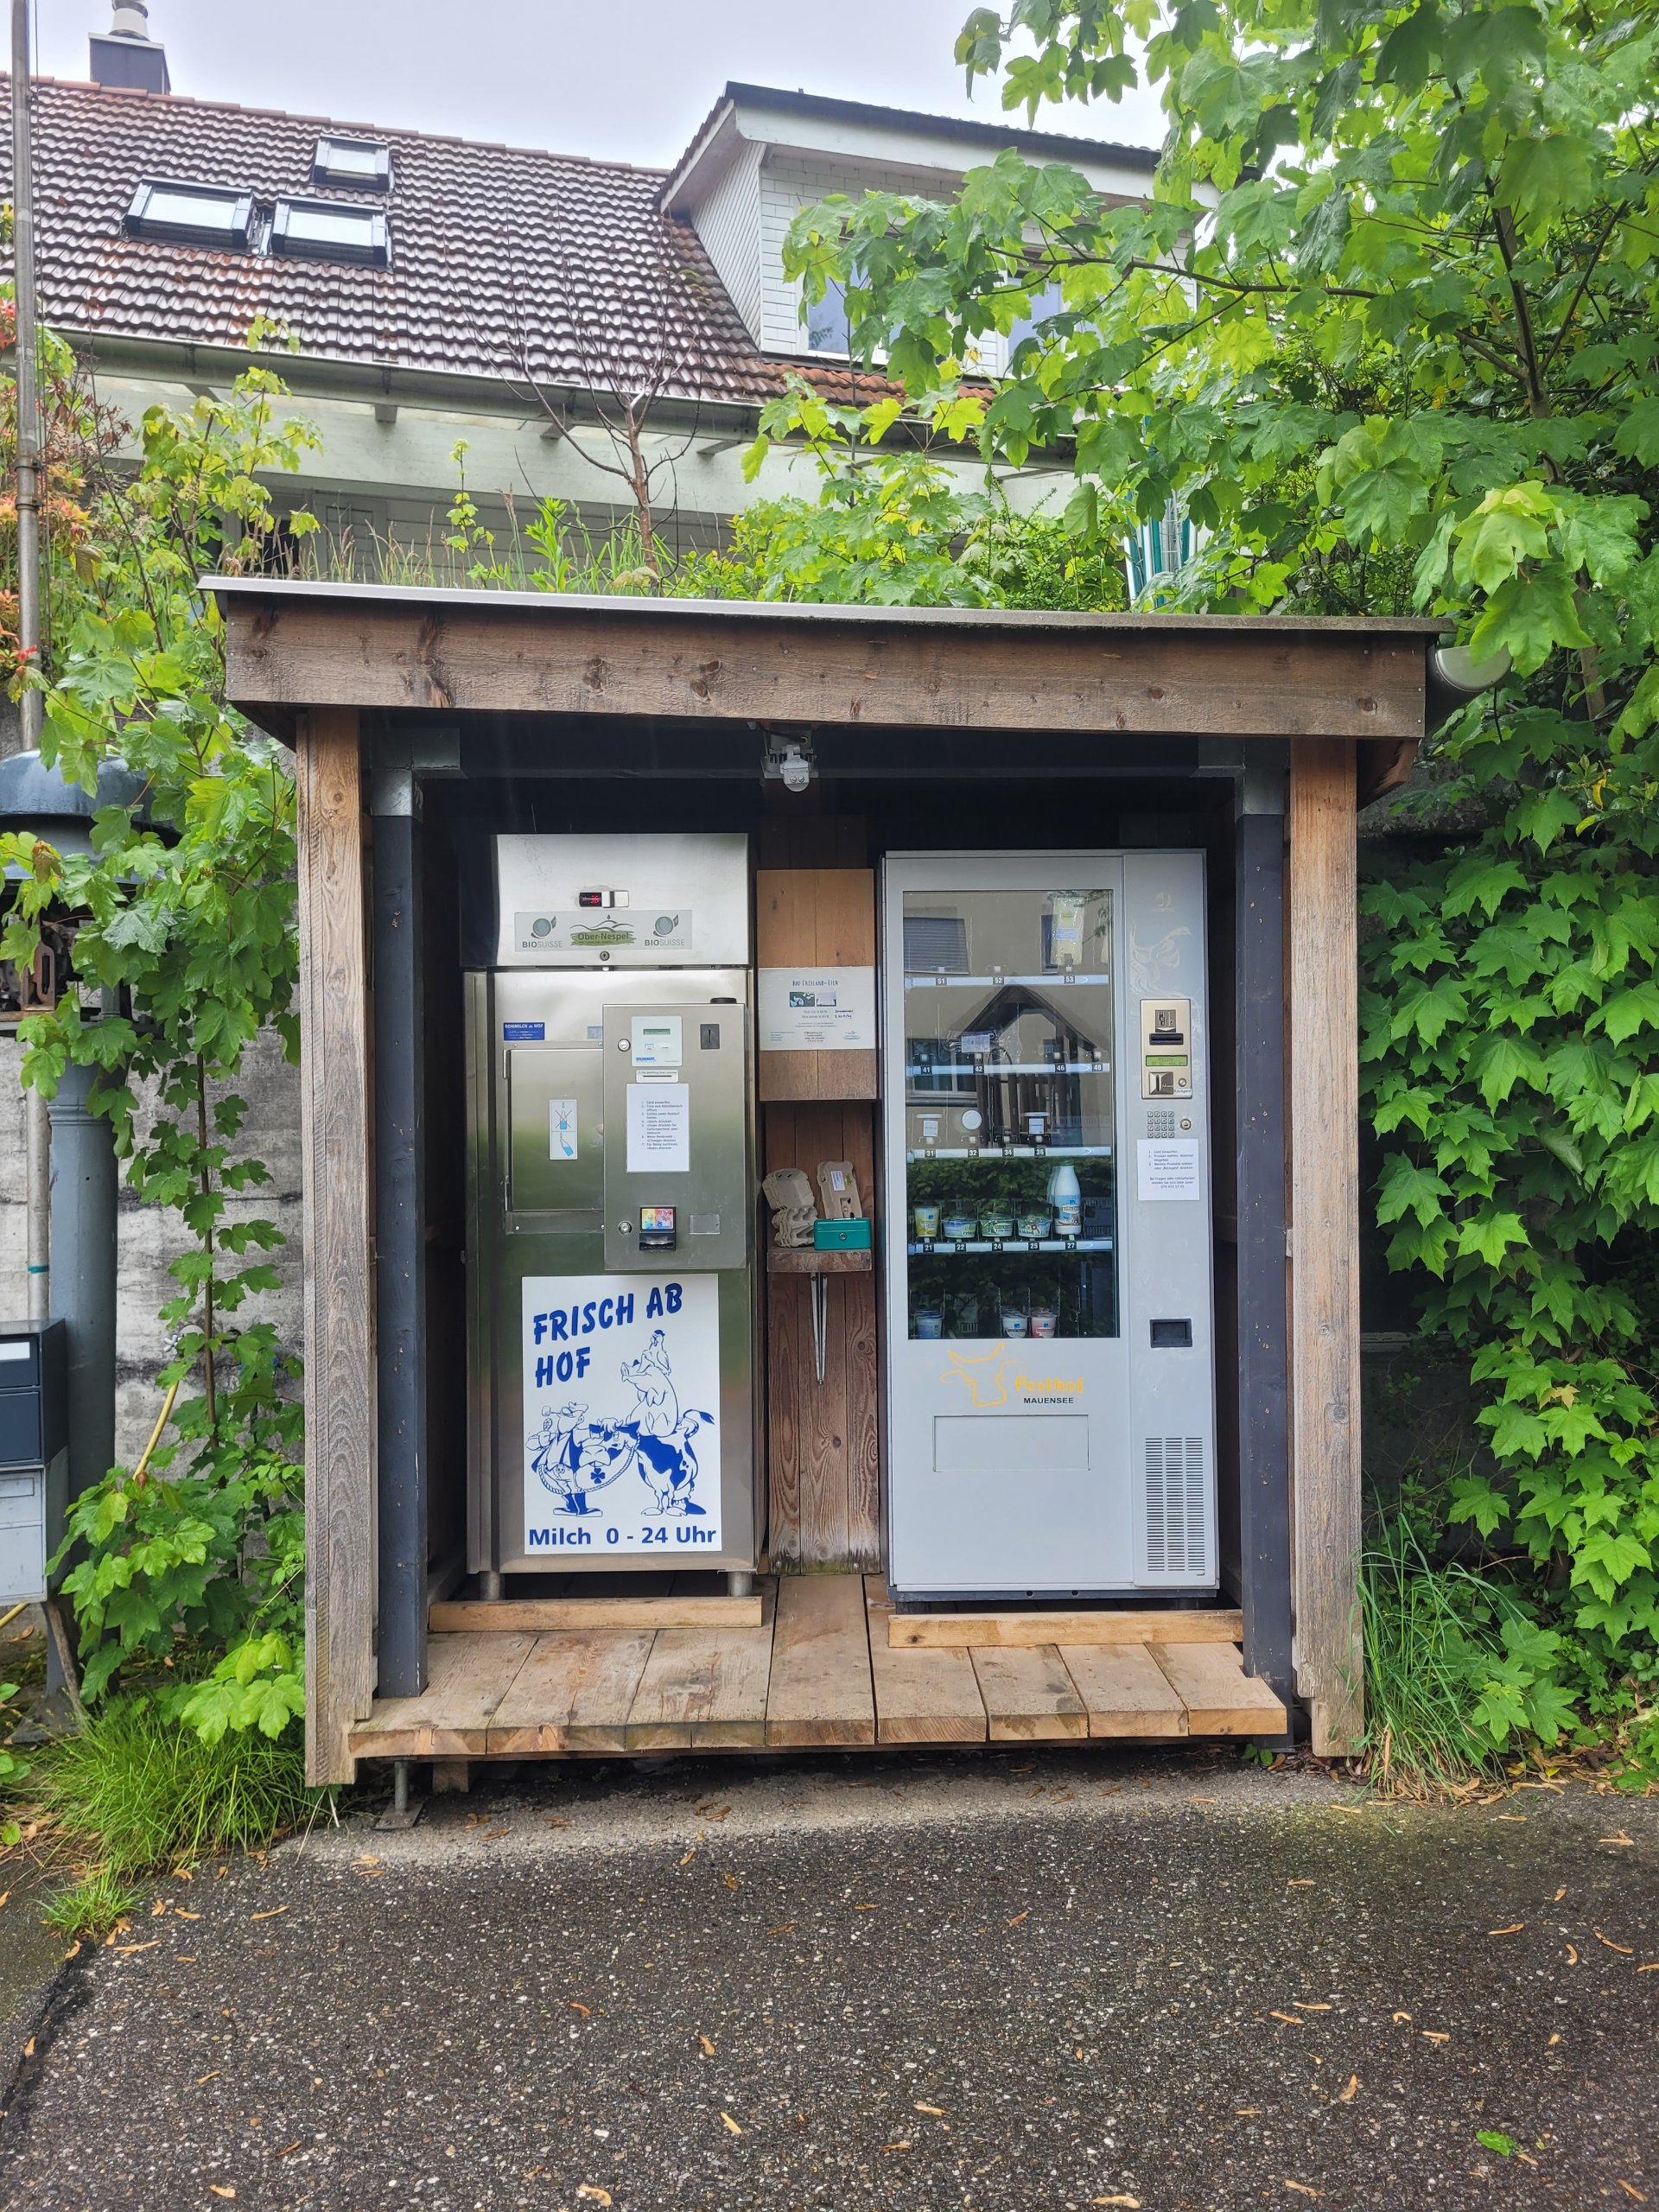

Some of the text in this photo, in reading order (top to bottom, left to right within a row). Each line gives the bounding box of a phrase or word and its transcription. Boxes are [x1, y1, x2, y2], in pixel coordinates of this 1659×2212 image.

[578, 932, 629, 941] Ober-Nespel
[533, 1282, 683, 1345] FRISCH AB
[535, 1346, 591, 1388] HOF
[1015, 1375, 1084, 1394] Posthof
[529, 1527, 591, 1546] Milch
[606, 1528, 619, 1545] 0
[641, 1527, 668, 1544] 24
[676, 1525, 716, 1542] Uhr
